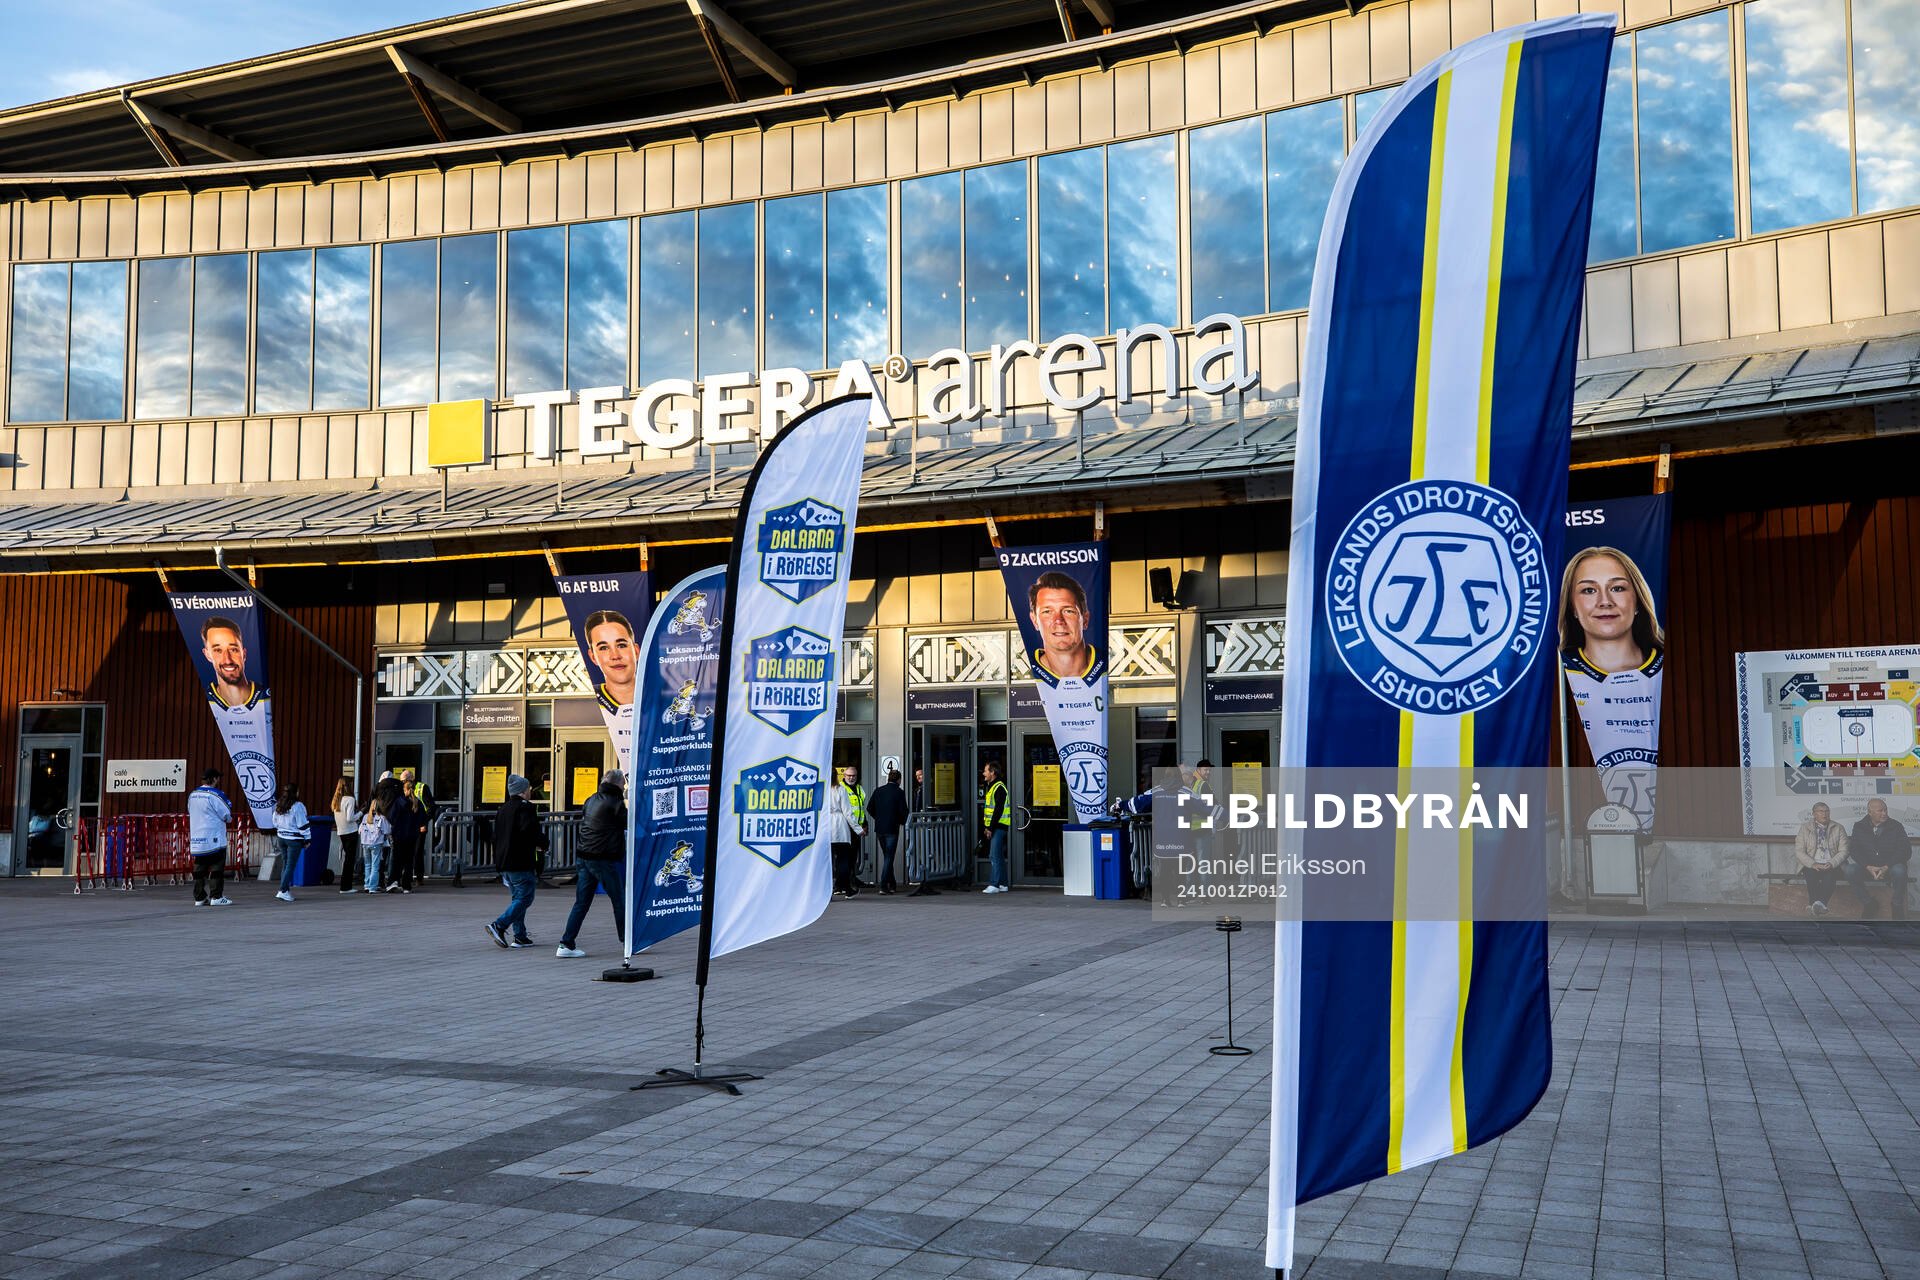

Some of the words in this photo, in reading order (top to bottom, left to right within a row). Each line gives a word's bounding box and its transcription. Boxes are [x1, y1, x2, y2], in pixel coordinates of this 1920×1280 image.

[927, 312, 1261, 424] arena
[770, 528, 835, 550] DALARNA
[1000, 553, 1010, 566] 9
[1011, 548, 1100, 567] ZACKRISSON
[1333, 504, 1396, 650] LEKSANDS
[1394, 486, 1542, 656] IDROTTSFÖRENING
[557, 581, 572, 593] 16
[573, 581, 588, 593] AF
[589, 579, 620, 593] BJUR
[170, 597, 184, 609] 15
[184, 595, 254, 609] VÉRONNEAU
[705, 643, 714, 651] IF
[1785, 652, 1836, 661] VÄLKOMMEN
[1837, 651, 1853, 659] TILL
[1855, 649, 1887, 658] TEGERA
[756, 658, 825, 680] DALARNA
[1370, 665, 1504, 711] ISHOCKEY
[1094, 695, 1105, 712] C
[1214, 693, 1274, 701] BILJETTINNEHAVARE
[1614, 696, 1650, 704] TEGERA
[914, 702, 968, 711] BILJETTINNEHAVARE
[466, 713, 495, 725] Ståplats
[496, 715, 520, 723] mitten
[697, 732, 706, 740] IF
[887, 761, 894, 772] 4
[1597, 758, 1612, 777] DS
[1611, 750, 1658, 764] IDROTT
[648, 767, 673, 777] STÖTTA
[114, 777, 138, 789] puck
[140, 777, 177, 787] munthe
[747, 788, 814, 810] DALARNA
[652, 895, 694, 907] Leksands
